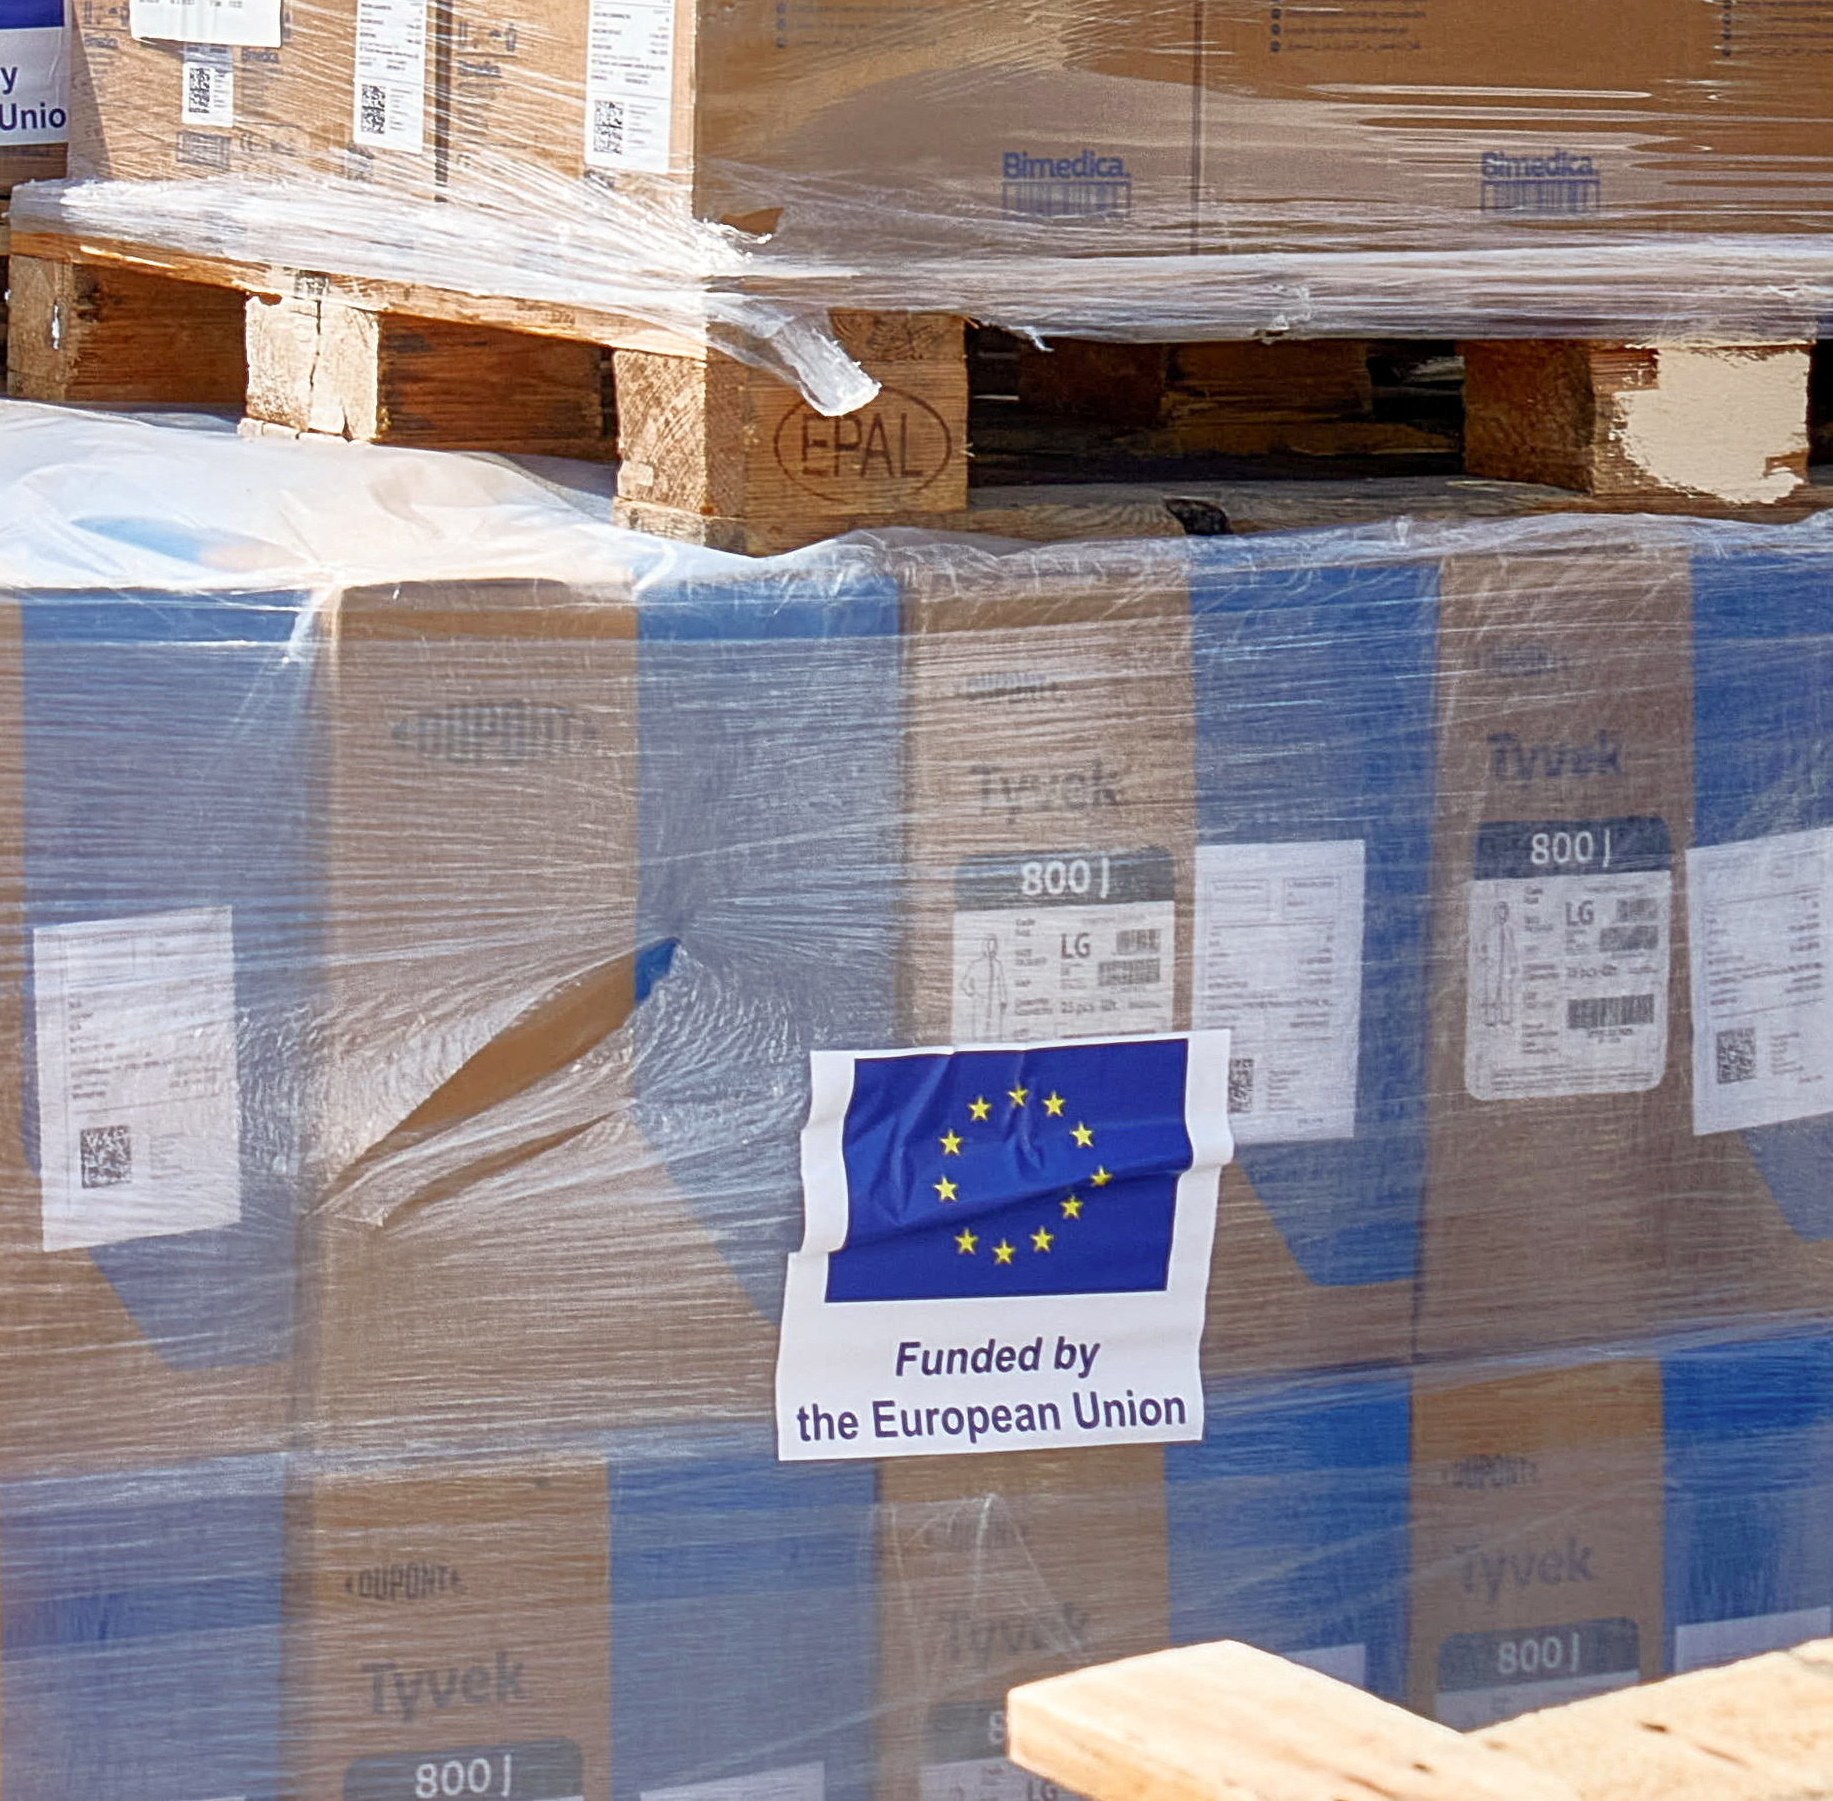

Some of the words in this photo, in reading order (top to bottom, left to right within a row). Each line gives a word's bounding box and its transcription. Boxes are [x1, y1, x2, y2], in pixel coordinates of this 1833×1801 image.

[801, 413, 923, 478] EPAL
[1532, 832, 1593, 865] 800
[1603, 830, 1610, 867] J
[1021, 862, 1090, 897] 800
[1100, 858, 1109, 898] J
[1566, 901, 1593, 926] LG
[1061, 933, 1090, 958] LG
[895, 1337, 1042, 1378] Funded
[1053, 1337, 1101, 1383] by
[797, 1406, 859, 1443] the
[872, 1400, 1061, 1448] European
[1074, 1389, 1187, 1433] Union
[1454, 1537, 1593, 1598] Tyvek
[1498, 1638, 1563, 1673] 800
[361, 1651, 526, 1722] Tyvek
[416, 1759, 491, 1798] 800
[501, 1754, 511, 1797] J
